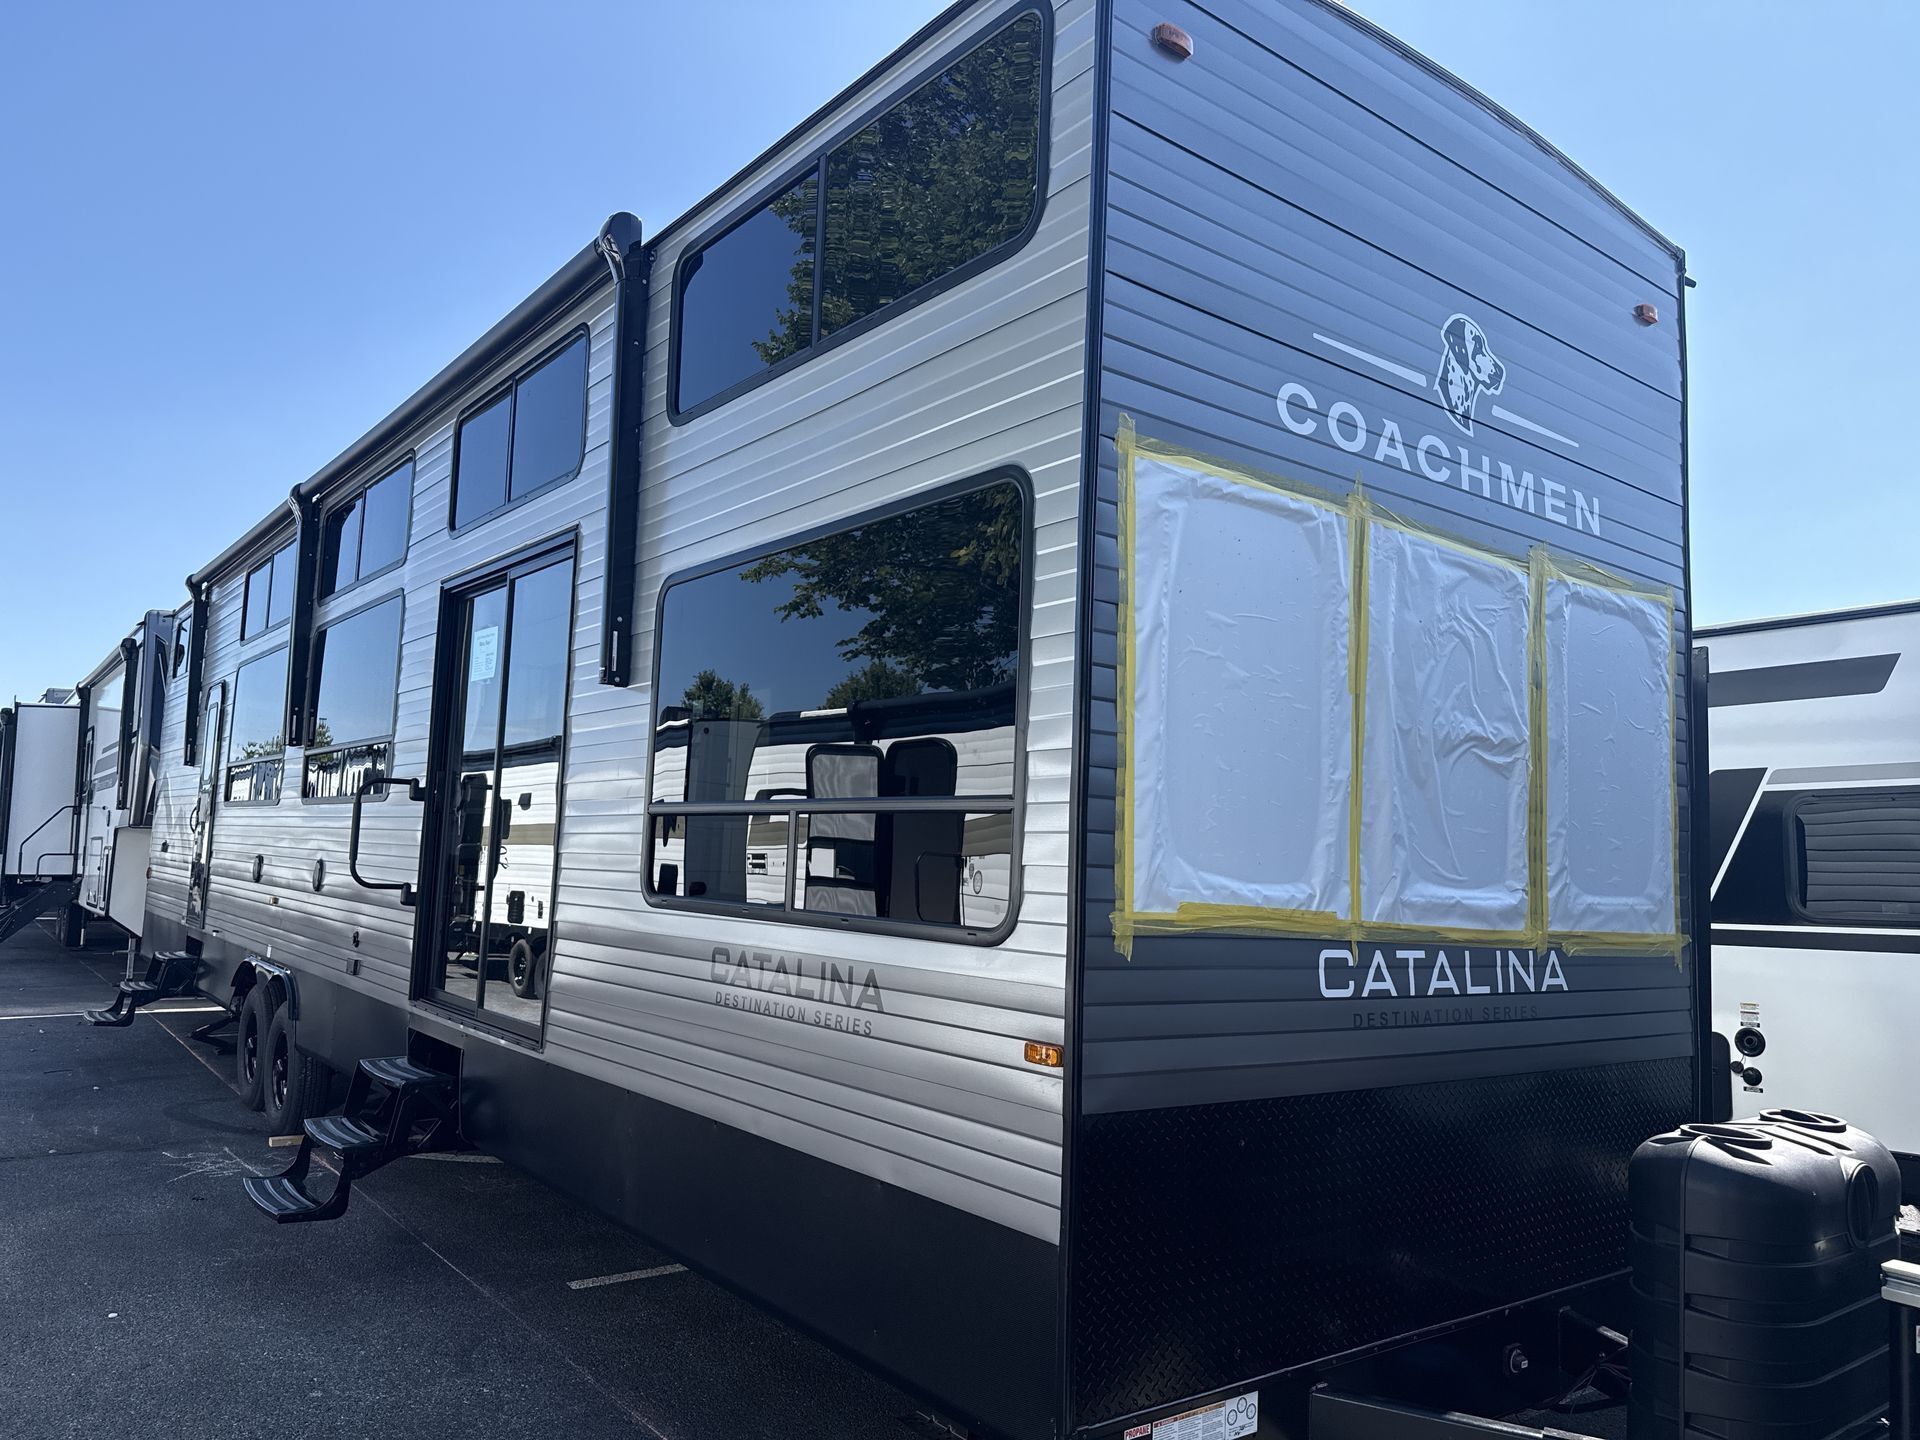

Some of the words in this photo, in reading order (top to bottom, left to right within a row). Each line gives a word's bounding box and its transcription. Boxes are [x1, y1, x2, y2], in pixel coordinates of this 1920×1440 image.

[1276, 382, 1601, 537] COACHMEN
[711, 947, 884, 1012] CATALINA
[1319, 949, 1568, 997] CATALINA
[716, 991, 806, 1021] DESTINATION
[814, 1010, 872, 1036] SERIES
[1353, 1007, 1472, 1028] DESTINATION
[1482, 1005, 1538, 1022] SERIES
[1125, 1424, 1150, 1439] PROPANE
